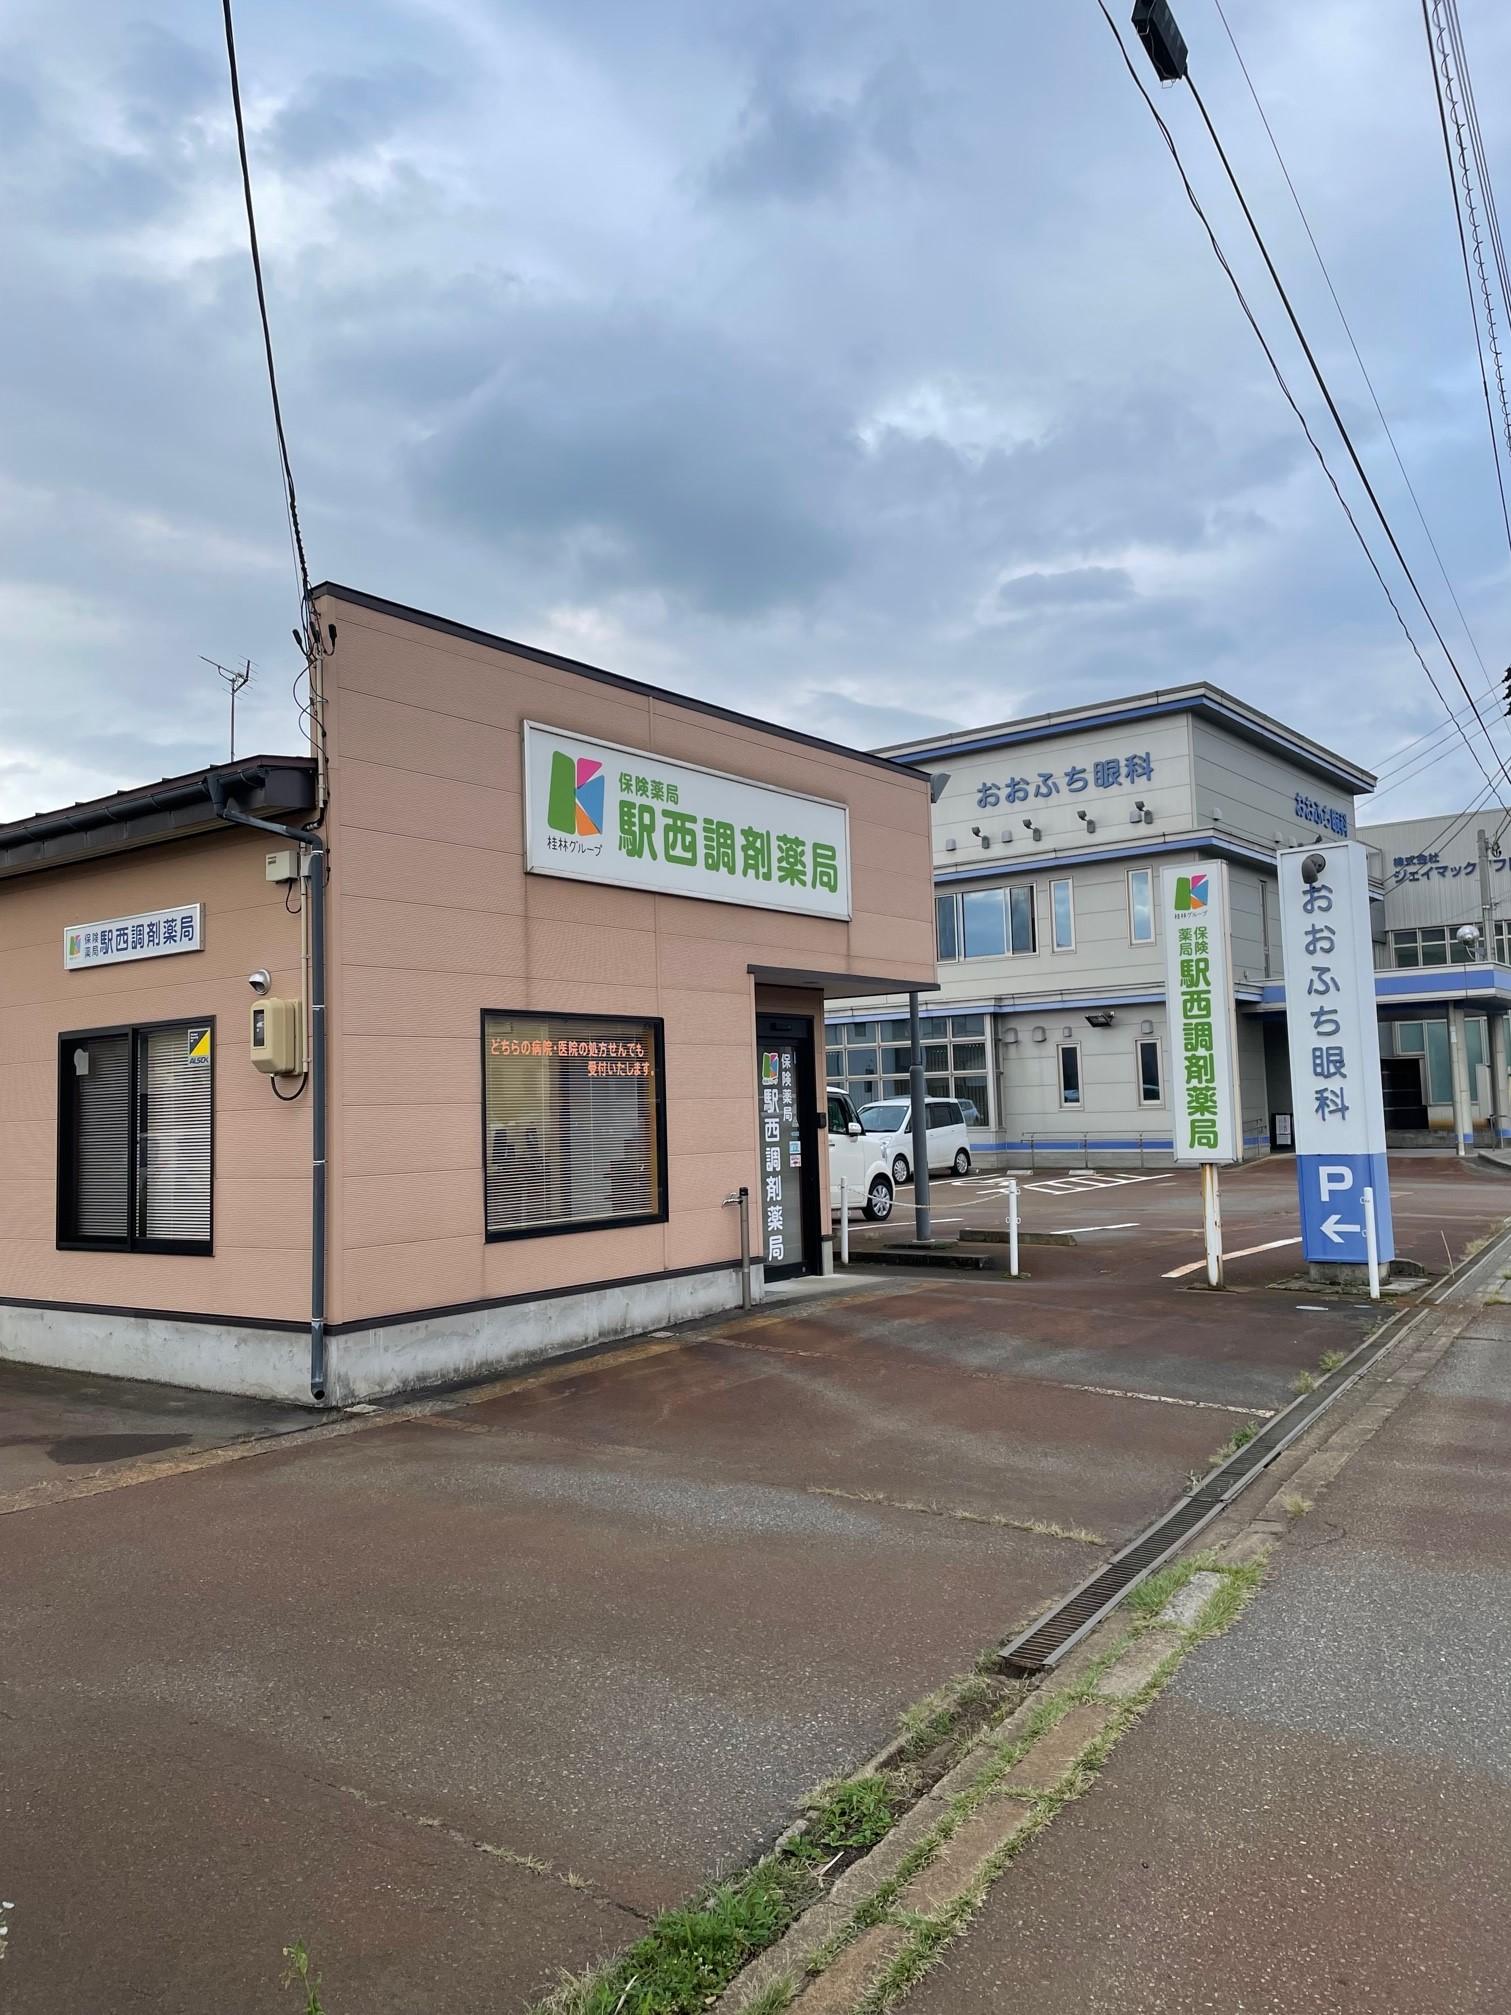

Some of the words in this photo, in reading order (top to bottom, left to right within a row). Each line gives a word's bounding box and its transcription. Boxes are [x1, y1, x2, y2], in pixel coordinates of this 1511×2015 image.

[618, 771, 679, 805] 保険薬局
[976, 751, 1155, 809] おおふち眼科
[547, 834, 603, 857] 桂林グループ
[618, 799, 839, 893] 駅西調剤薬局
[1393, 852, 1440, 868] 株式会社
[100, 915, 194, 955] 駅西調剤薬局
[1178, 928, 1193, 956] 薬局
[1194, 926, 1209, 955] 保険
[1302, 883, 1349, 1122] おおふち眼科
[1180, 957, 1219, 1149] 駅西調剤薬局
[781, 1053, 793, 1122] 保険薬局
[763, 1088, 784, 1262] 駅西調剤薬局
[1318, 1166, 1354, 1202] P
